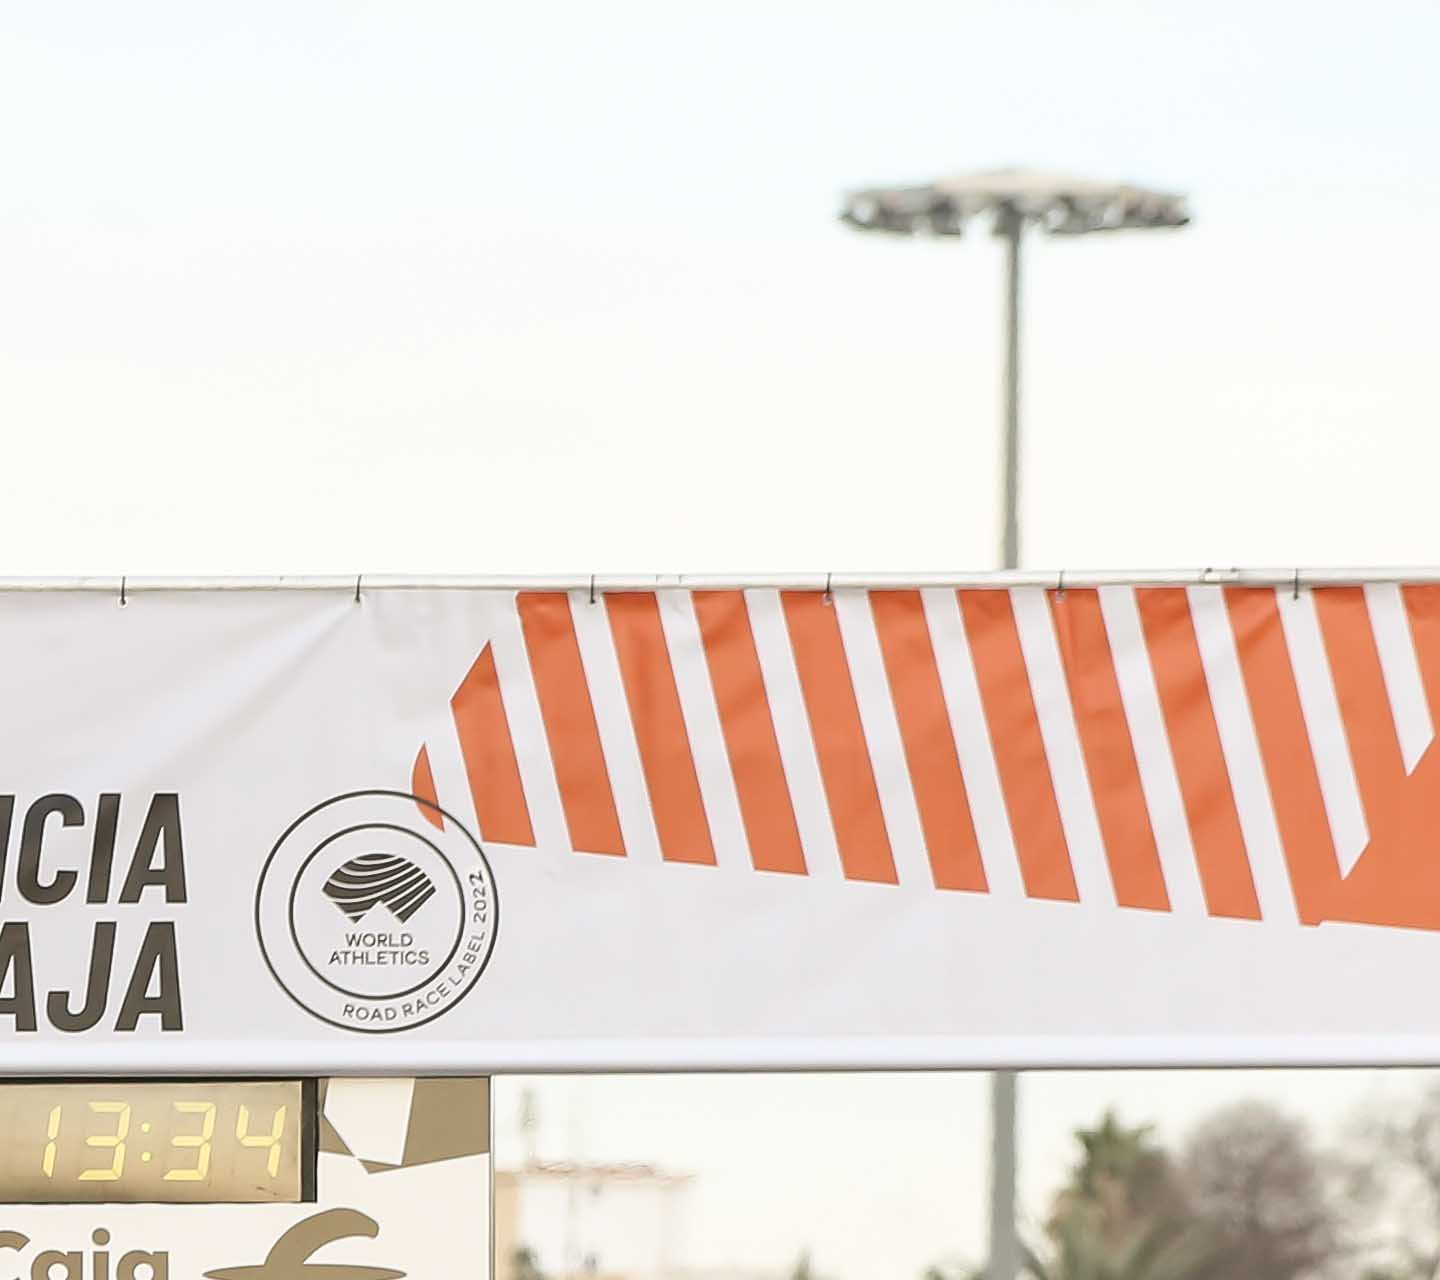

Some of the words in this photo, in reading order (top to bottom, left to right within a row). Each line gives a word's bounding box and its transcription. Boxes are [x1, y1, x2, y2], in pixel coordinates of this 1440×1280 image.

[342, 1003, 397, 1021] ROAD
[402, 983, 450, 1017] RACE
[448, 931, 486, 986] LABEL
[468, 869, 487, 923] 2022
[345, 932, 414, 948] WORLD
[328, 950, 430, 966] ATHLETICS
